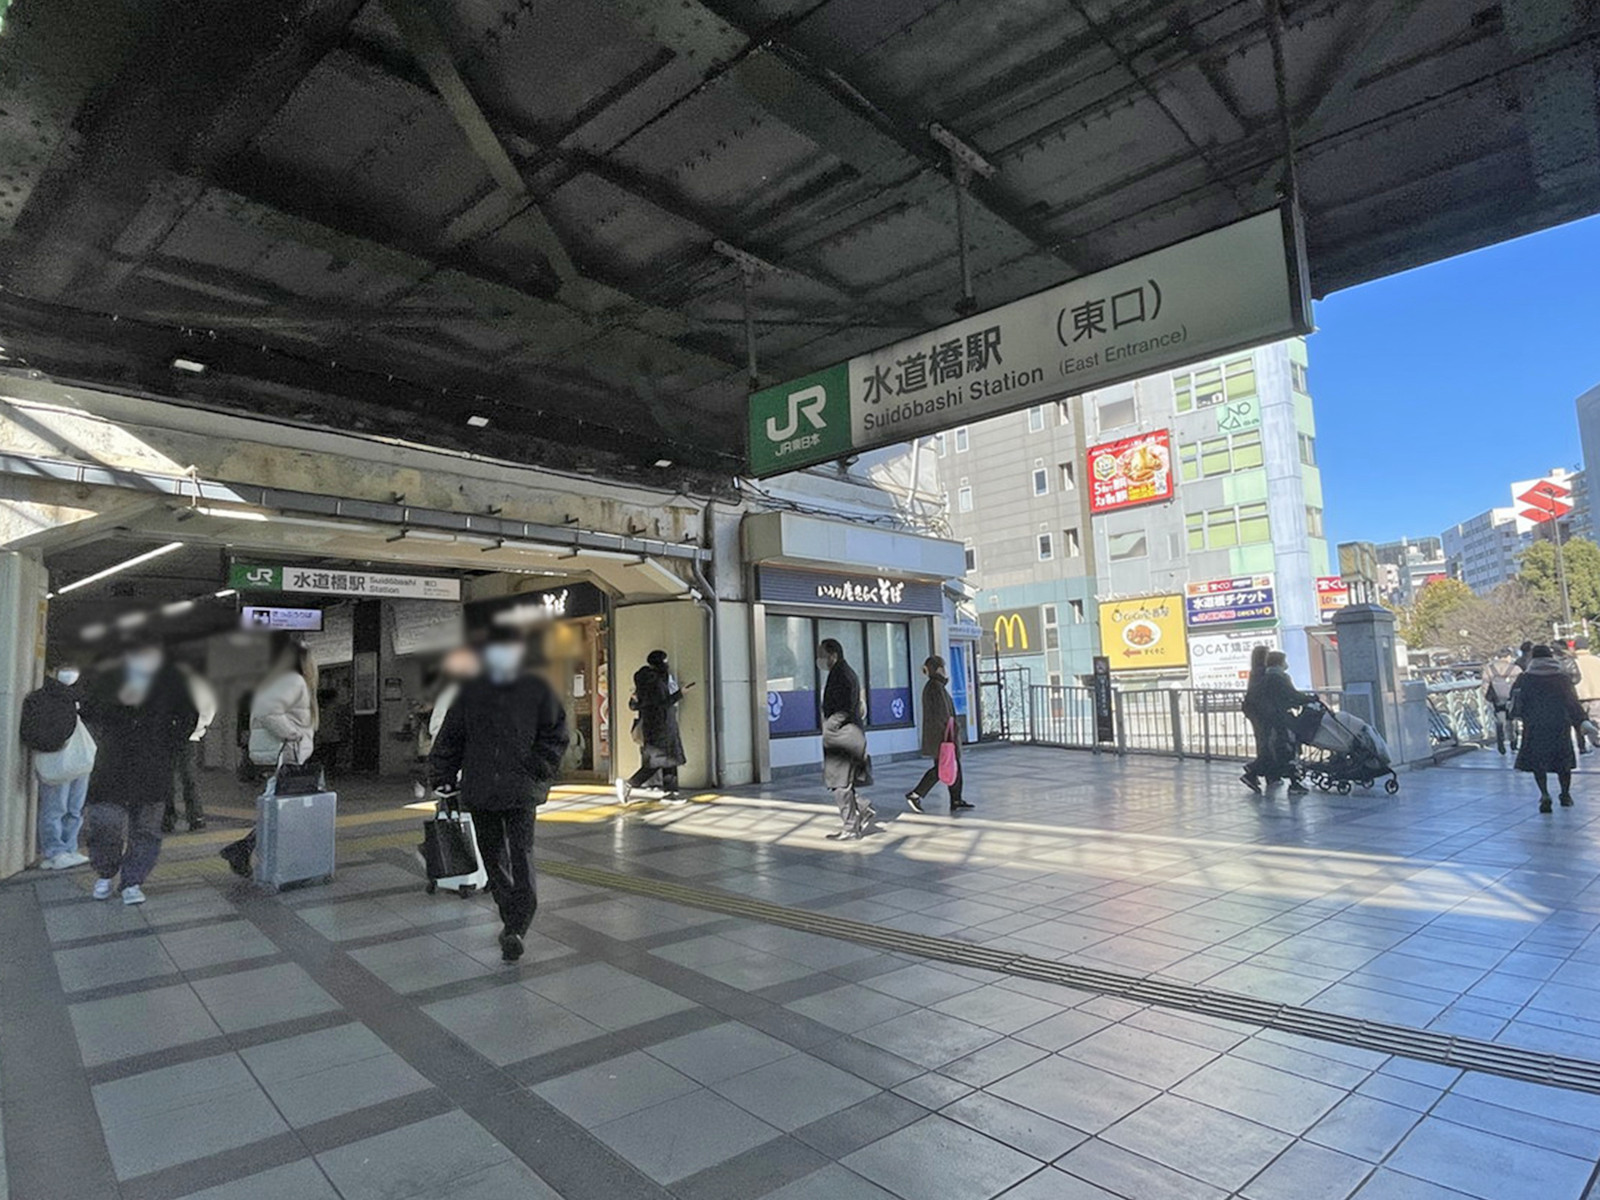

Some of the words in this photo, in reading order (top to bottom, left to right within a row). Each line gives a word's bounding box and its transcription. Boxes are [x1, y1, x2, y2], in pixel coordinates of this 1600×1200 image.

[863, 325, 1003, 404] 水道橋駅
[1056, 279, 1162, 347] (東口)
[863, 386, 963, 430] Suidōbashi
[969, 367, 1044, 400] Station
[1059, 352, 1099, 377] (East
[1104, 324, 1188, 363] Entrance)
[766, 384, 828, 442] JR
[774, 432, 821, 457] JR東日本
[246, 568, 274, 583] JR
[293, 571, 366, 591] 水道橋駅
